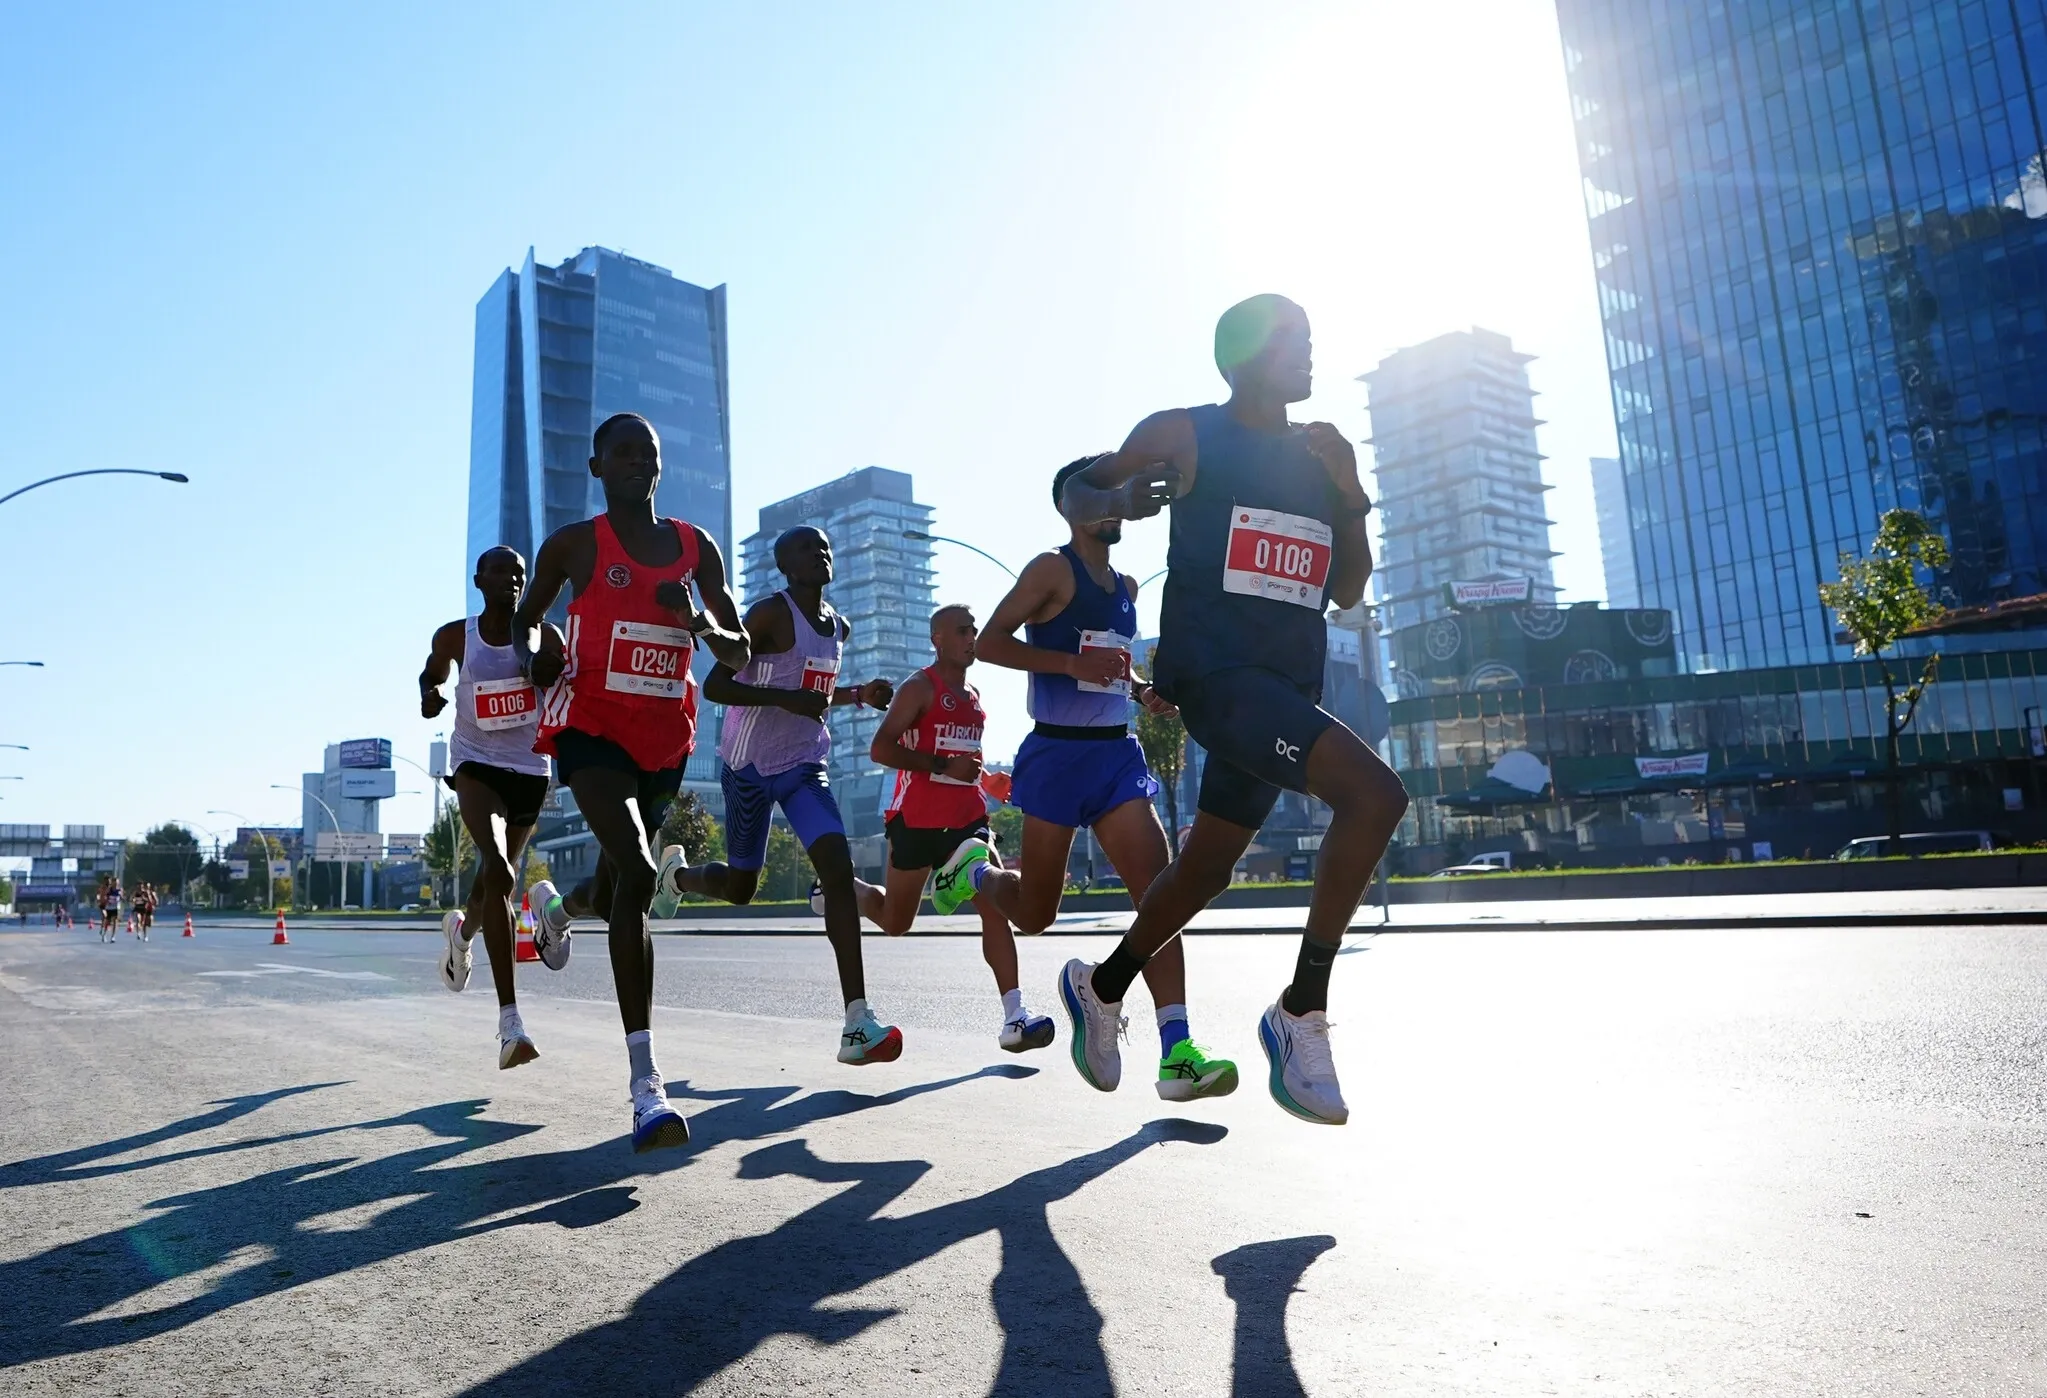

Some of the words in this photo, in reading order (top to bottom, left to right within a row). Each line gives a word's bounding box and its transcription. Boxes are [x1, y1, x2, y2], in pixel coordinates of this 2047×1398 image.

[1255, 538, 1313, 578] 0108
[631, 646, 678, 676] 0294
[489, 693, 525, 715] 0106
[934, 722, 982, 740] TÜRKİY
